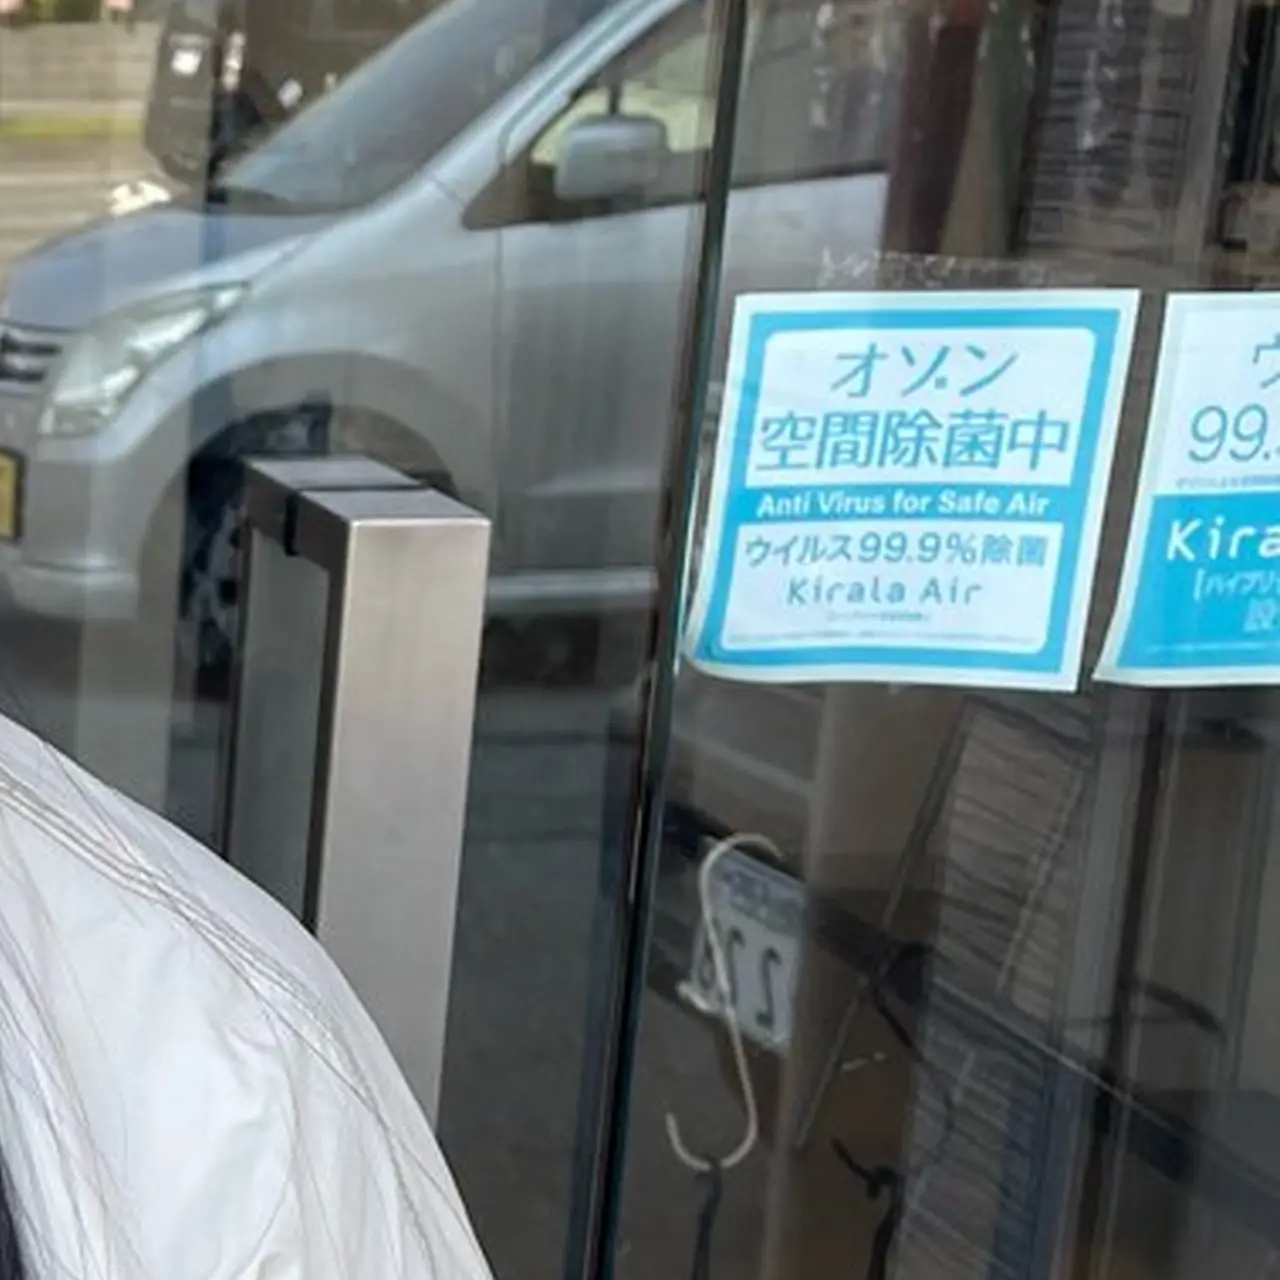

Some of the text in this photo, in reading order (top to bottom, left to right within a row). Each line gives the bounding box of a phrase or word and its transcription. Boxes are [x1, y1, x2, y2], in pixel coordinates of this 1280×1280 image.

[755, 408, 1071, 471] 空間除菌中
[1188, 402, 1280, 463] 99.
[756, 490, 1050, 518] Anti Virus for Safe Air
[786, 576, 984, 606] Kirala Air
